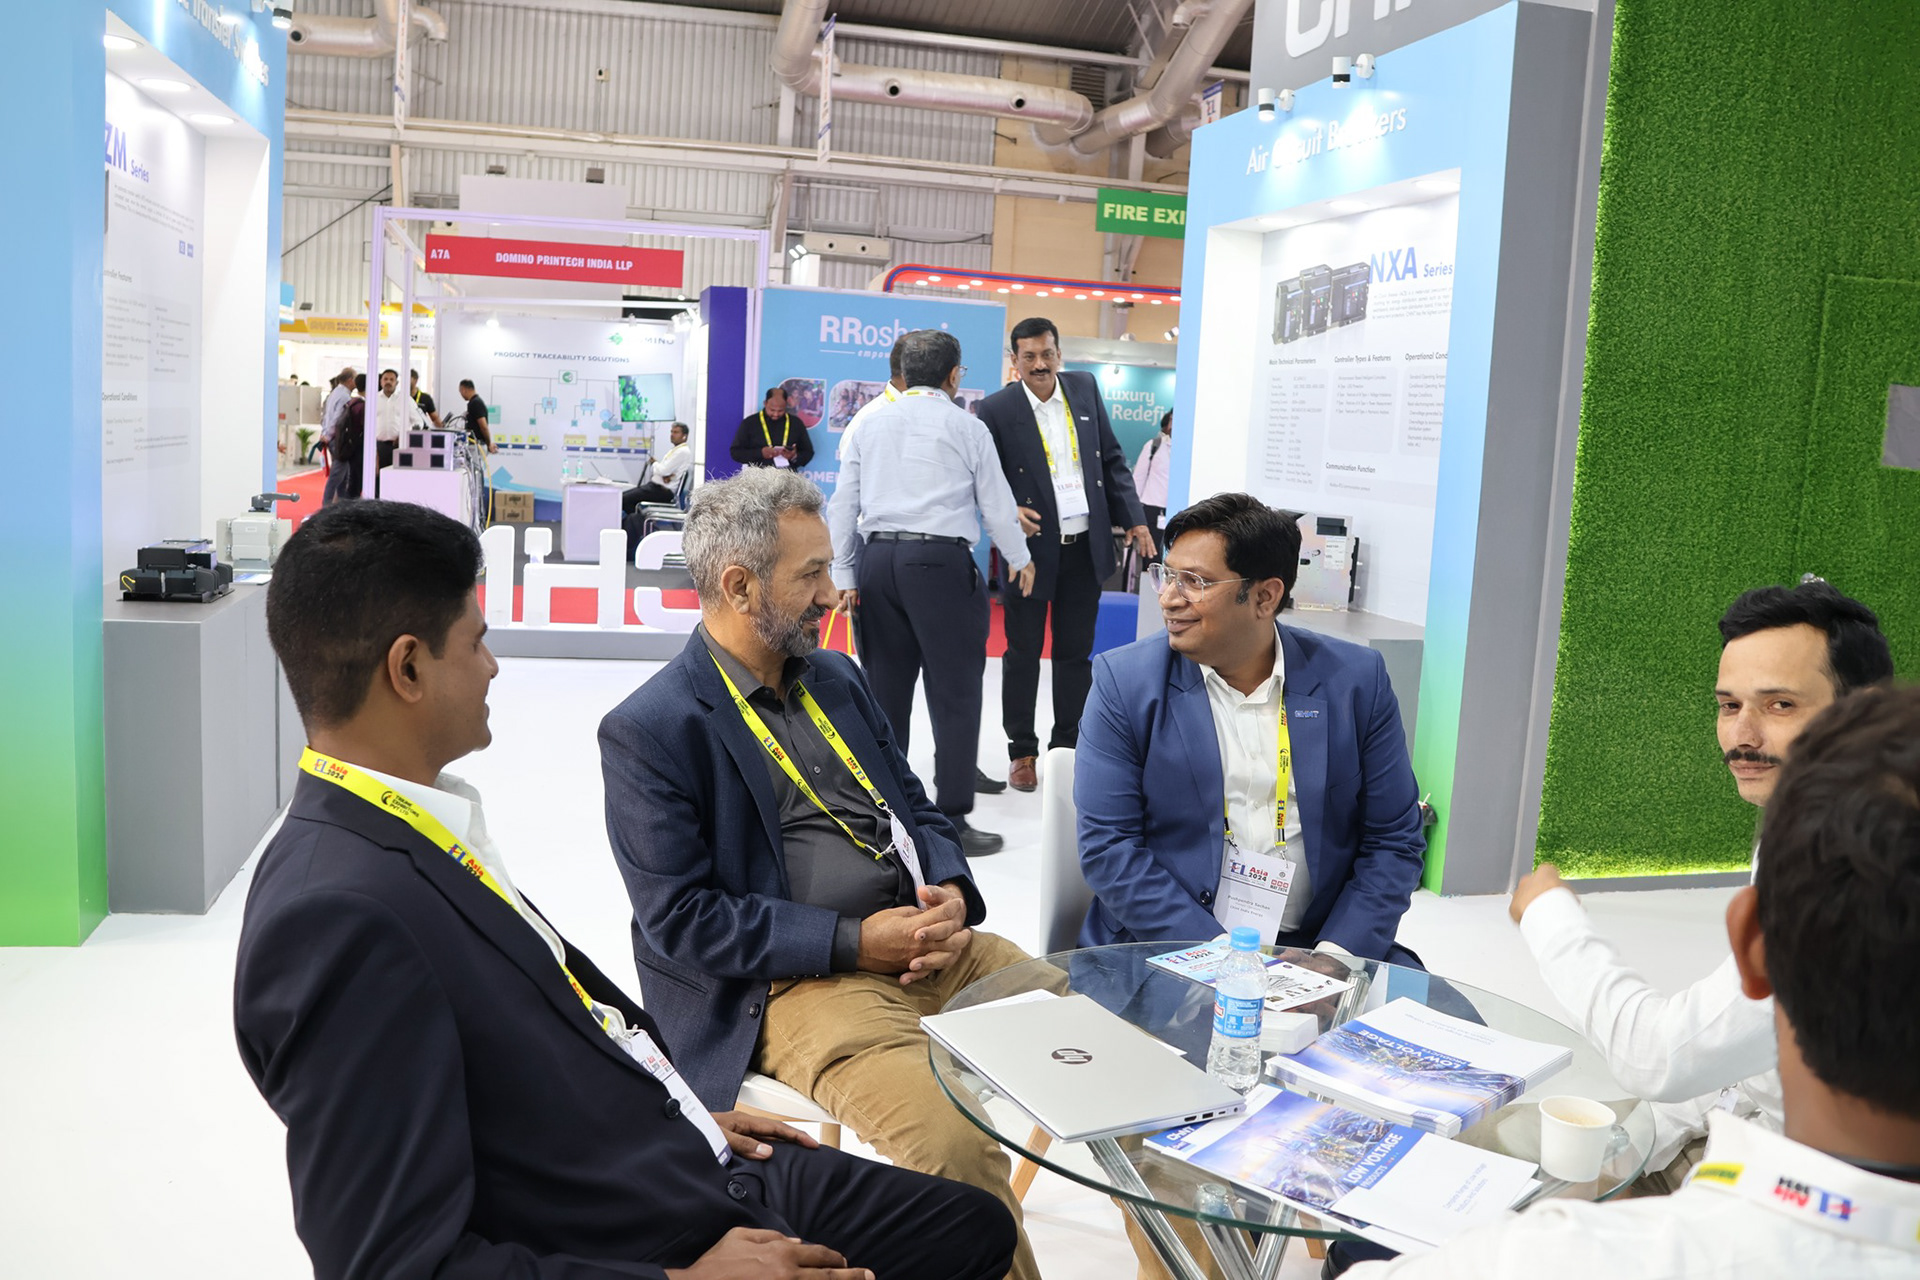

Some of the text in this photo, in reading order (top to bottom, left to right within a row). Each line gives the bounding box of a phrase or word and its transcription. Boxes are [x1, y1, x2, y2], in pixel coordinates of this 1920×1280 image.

[131, 159, 149, 183] Series
[1246, 146, 1268, 175] Air
[1103, 202, 1186, 225] FIRE EXI
[430, 248, 633, 271] A7A DOMINO PRINTECH INDIA LLP
[1369, 247, 1453, 284] NXA Series
[494, 351, 630, 364] PRODUCT TRACEABILITY SOLUTIONS
[1334, 355, 1354, 363] Controller
[1372, 354, 1391, 362] Features
[1405, 352, 1434, 361] Operational
[1104, 387, 1155, 406] Luxury
[1112, 403, 1165, 426] Redefi
[1325, 463, 1376, 473] Communication Function
[314, 757, 330, 775] EL
[326, 768, 345, 781] 2024
[329, 762, 348, 775] Asia
[447, 843, 467, 867] EL
[467, 858, 484, 877] Asia
[1230, 861, 1268, 877] EL Asia
[1248, 872, 1267, 882] 2024
[1358, 1029, 1423, 1060] VOLTAGE
[1423, 1054, 1462, 1069] LOW
[1343, 1132, 1404, 1185] LOW VOLTAGE
[1360, 1165, 1388, 1188] PRODUCTS
[1773, 1185, 1810, 1209] Asia
[1813, 1188, 1854, 1222] EL
